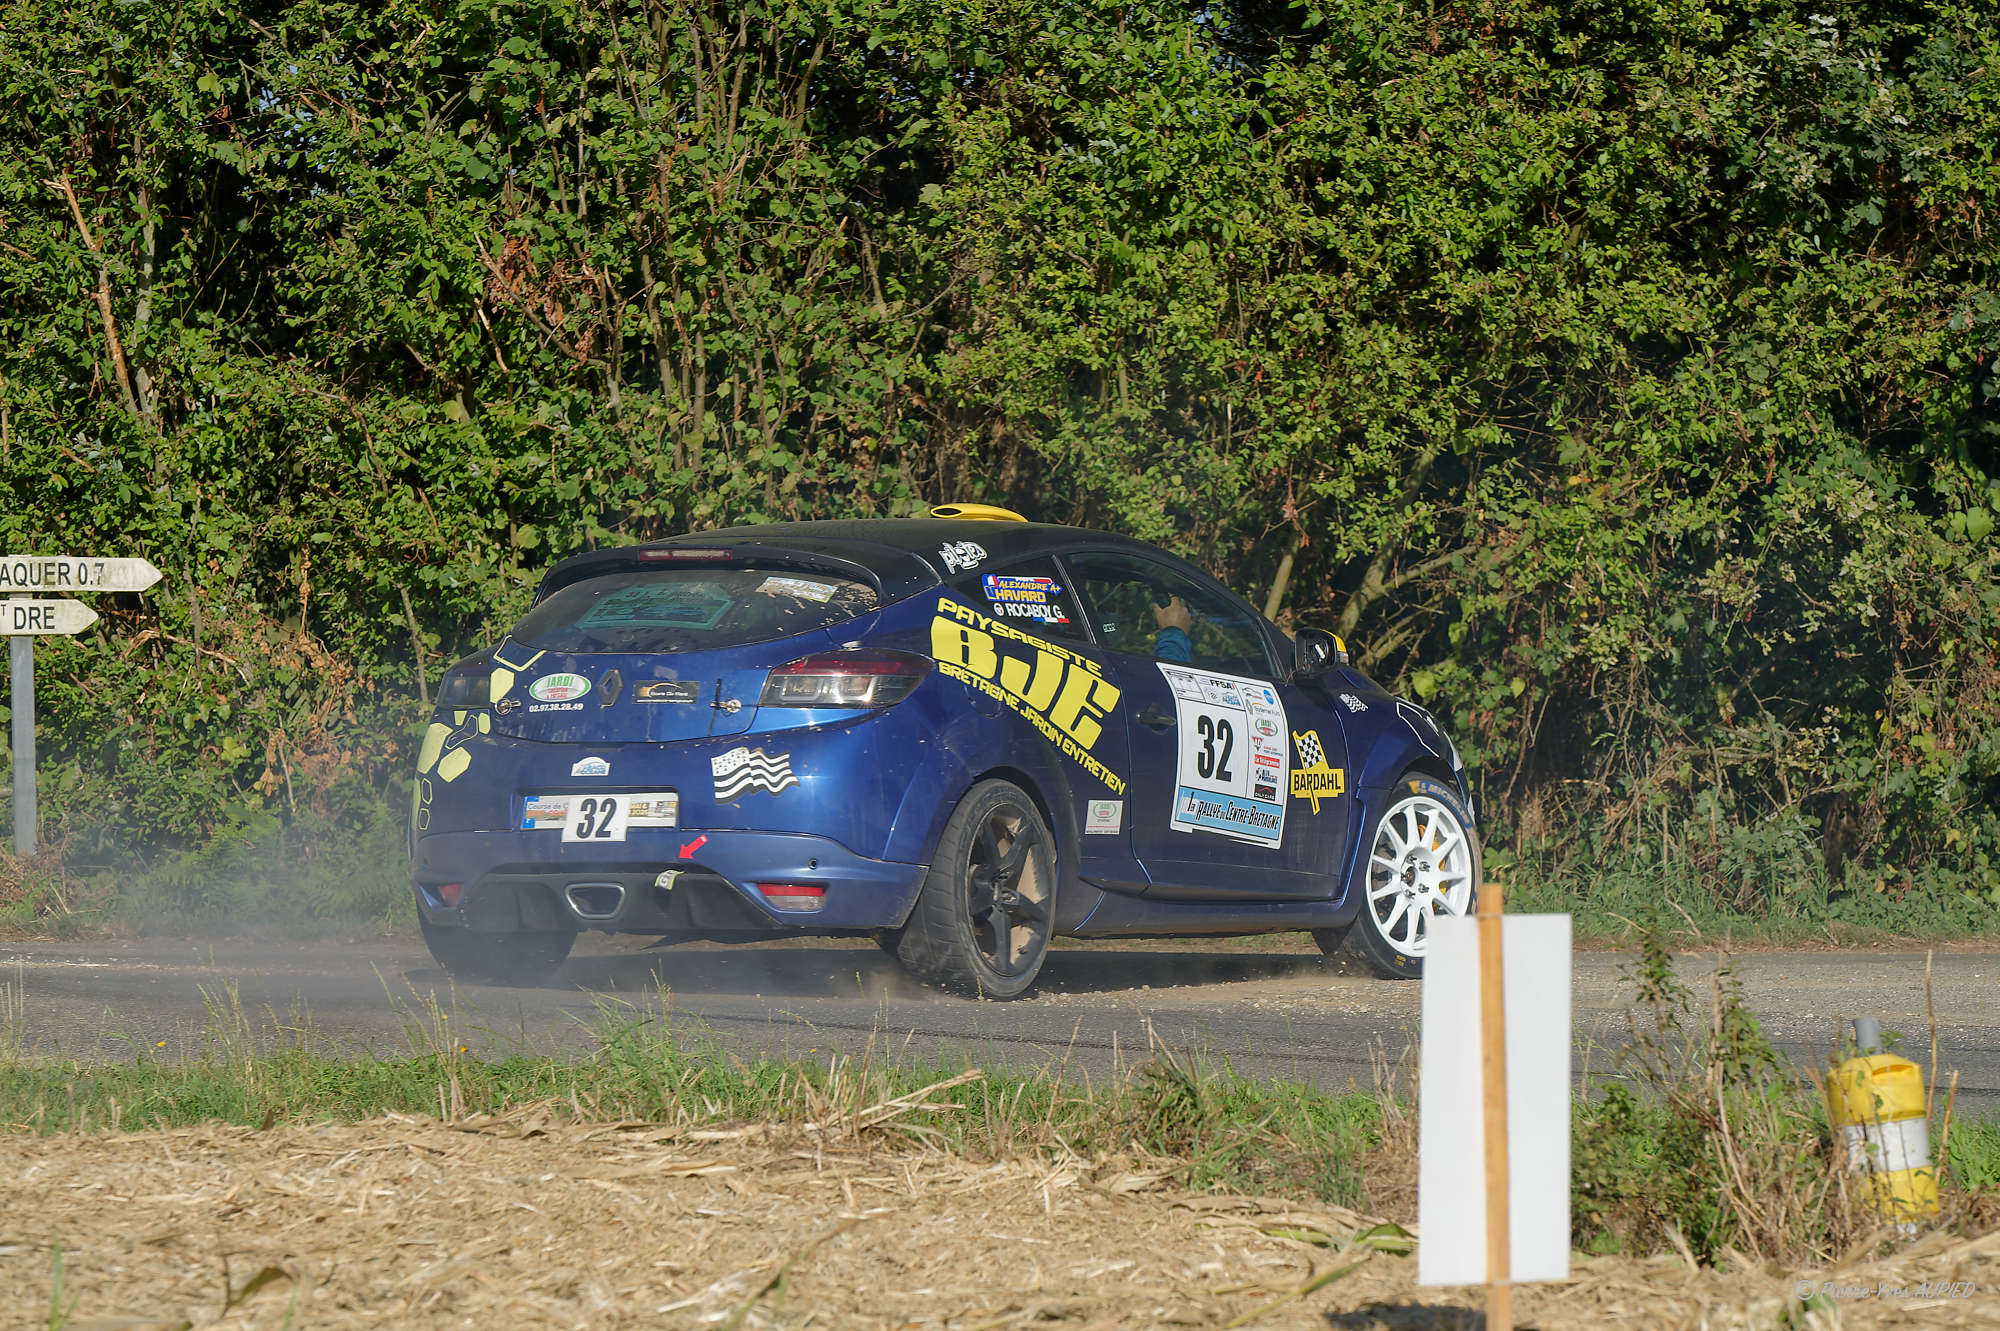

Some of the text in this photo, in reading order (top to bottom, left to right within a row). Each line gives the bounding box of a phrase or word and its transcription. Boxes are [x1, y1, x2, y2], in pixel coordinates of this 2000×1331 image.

[78, 562, 104, 585] 0.7
[995, 590, 1047, 603] HAVARD
[998, 580, 1048, 591] ALEXANDRE
[14, 606, 55, 629] DRE
[1007, 603, 1052, 618] ROCABOY
[938, 597, 1102, 676] PAYSAGISTE
[931, 615, 1120, 751] BJE
[1210, 680, 1232, 689] FFSA
[939, 661, 1127, 796] BRETAGNE JARDIN ENTRETIEN
[1197, 715, 1233, 783] 32
[1293, 772, 1341, 791] BARDAHL
[576, 798, 617, 839] 32
